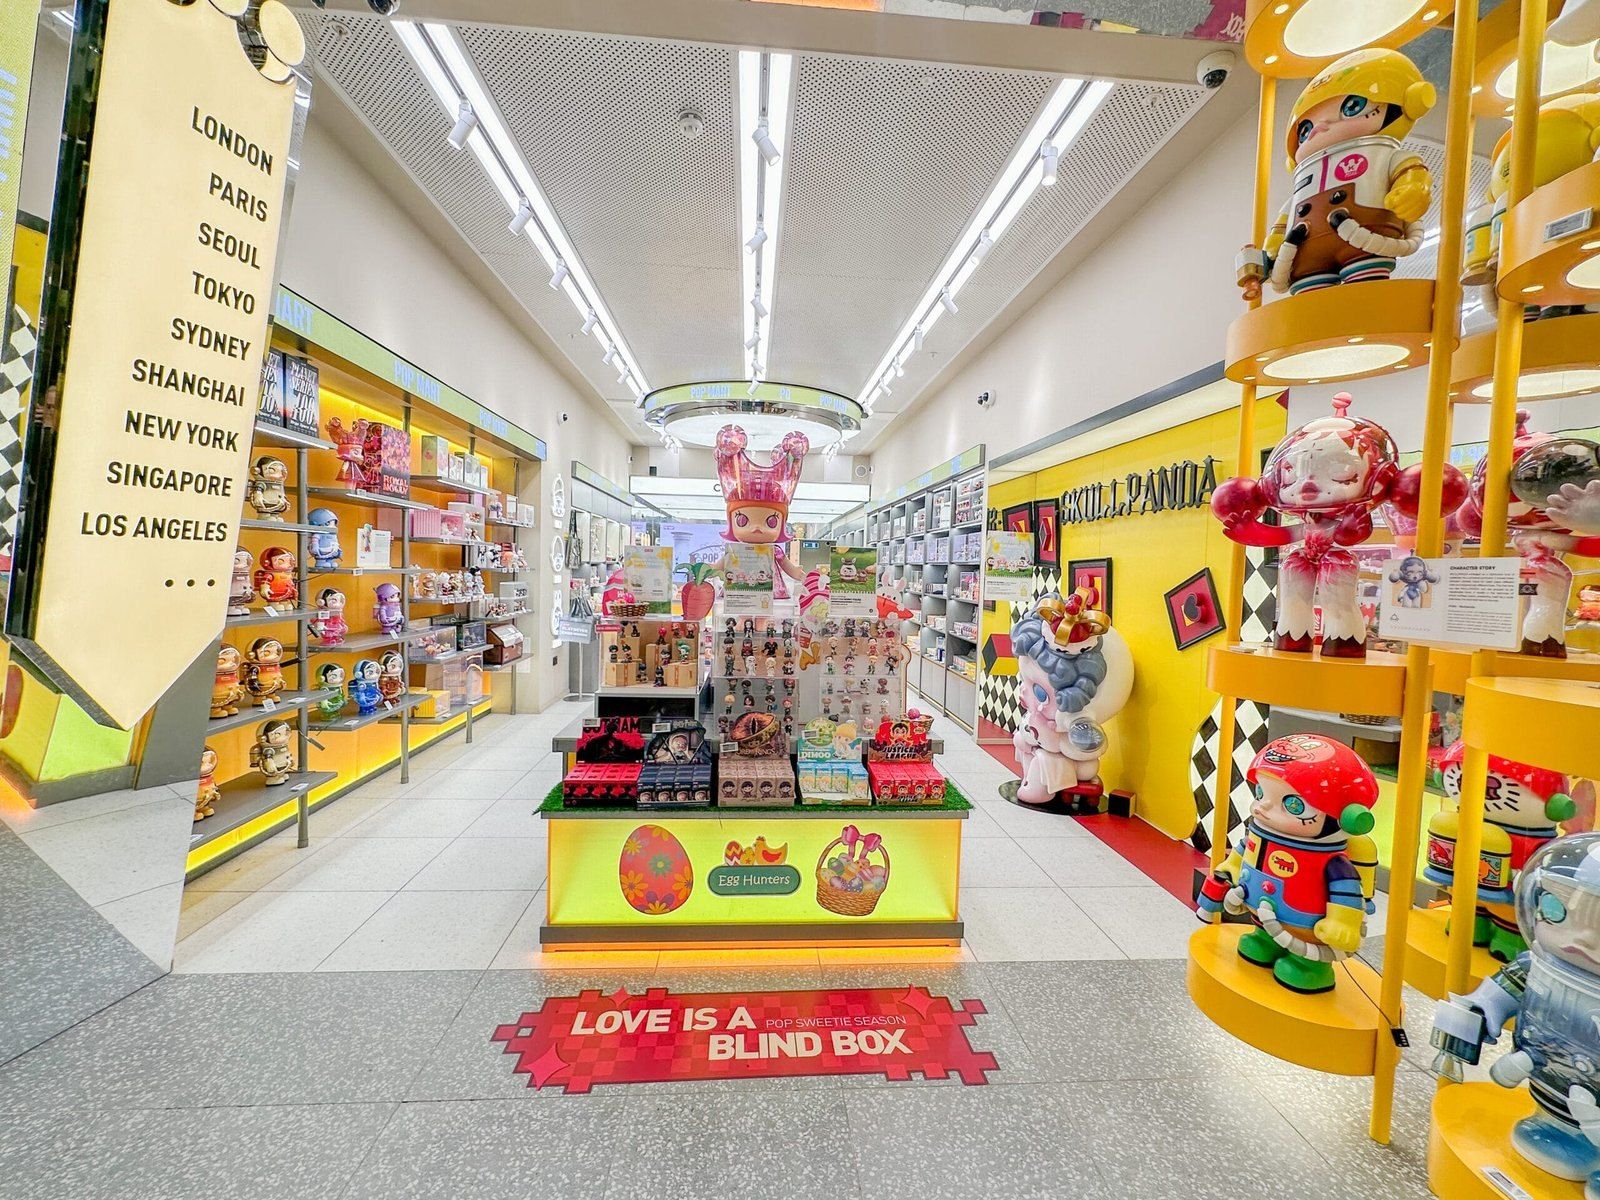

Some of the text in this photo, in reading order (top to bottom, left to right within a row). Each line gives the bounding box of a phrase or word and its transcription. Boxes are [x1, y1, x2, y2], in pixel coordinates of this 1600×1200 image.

[191, 105, 273, 176] LONDON
[208, 172, 268, 222] PARIS
[198, 222, 260, 270] SEOUL
[192, 271, 255, 315] TOKYO
[171, 317, 251, 361] SYDNEY
[132, 358, 245, 407] SHANGHAI
[395, 361, 440, 403] POP MART
[691, 385, 730, 399] POP MART
[125, 411, 239, 452] NEW YORK
[107, 461, 233, 497] SINGAPORE
[383, 475, 408, 487] ROYAL
[1061, 455, 1217, 525] SKULLPANDA
[82, 512, 227, 541] LOS ANGELES
[718, 874, 791, 886] Egg Hunters
[571, 1007, 906, 1034] LOVE IS A POP SWEETIE SEASON
[709, 1028, 913, 1060] BLIND BOX
